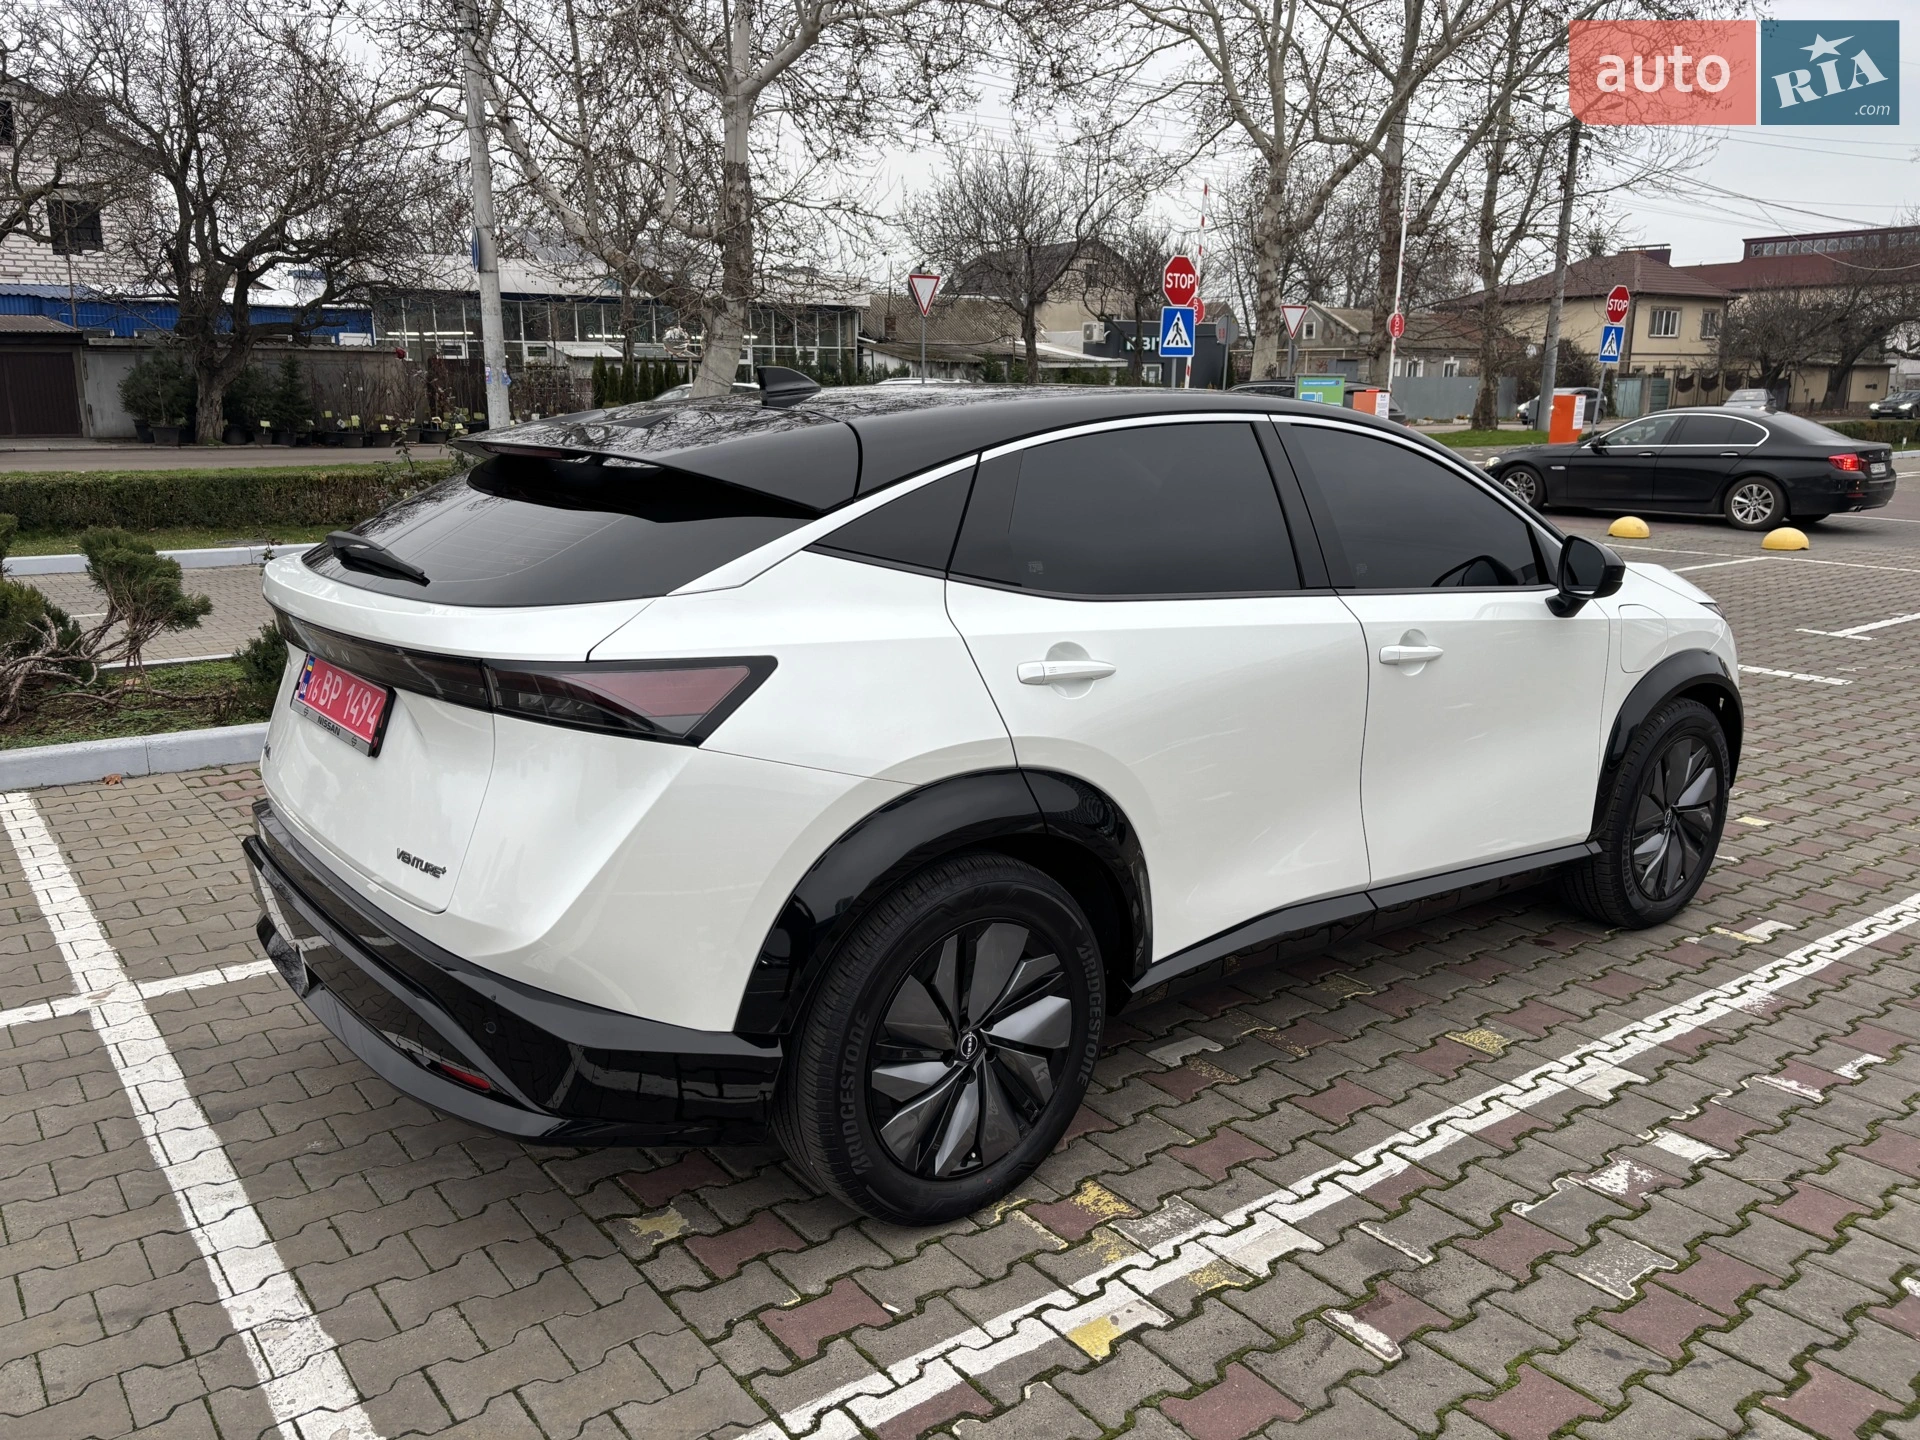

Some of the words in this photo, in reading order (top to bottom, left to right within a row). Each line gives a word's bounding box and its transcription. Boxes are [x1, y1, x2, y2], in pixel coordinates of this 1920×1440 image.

[1165, 272, 1195, 289] STOP
[1607, 298, 1628, 312] STOP
[1126, 336, 1160, 351] КВІ
[307, 674, 322, 702] 16
[343, 683, 382, 735] 1494
[317, 715, 341, 736] NISSAN
[1075, 942, 1101, 1087] BRIDGESTONE
[839, 1010, 871, 1175] BRIDGESTONE
